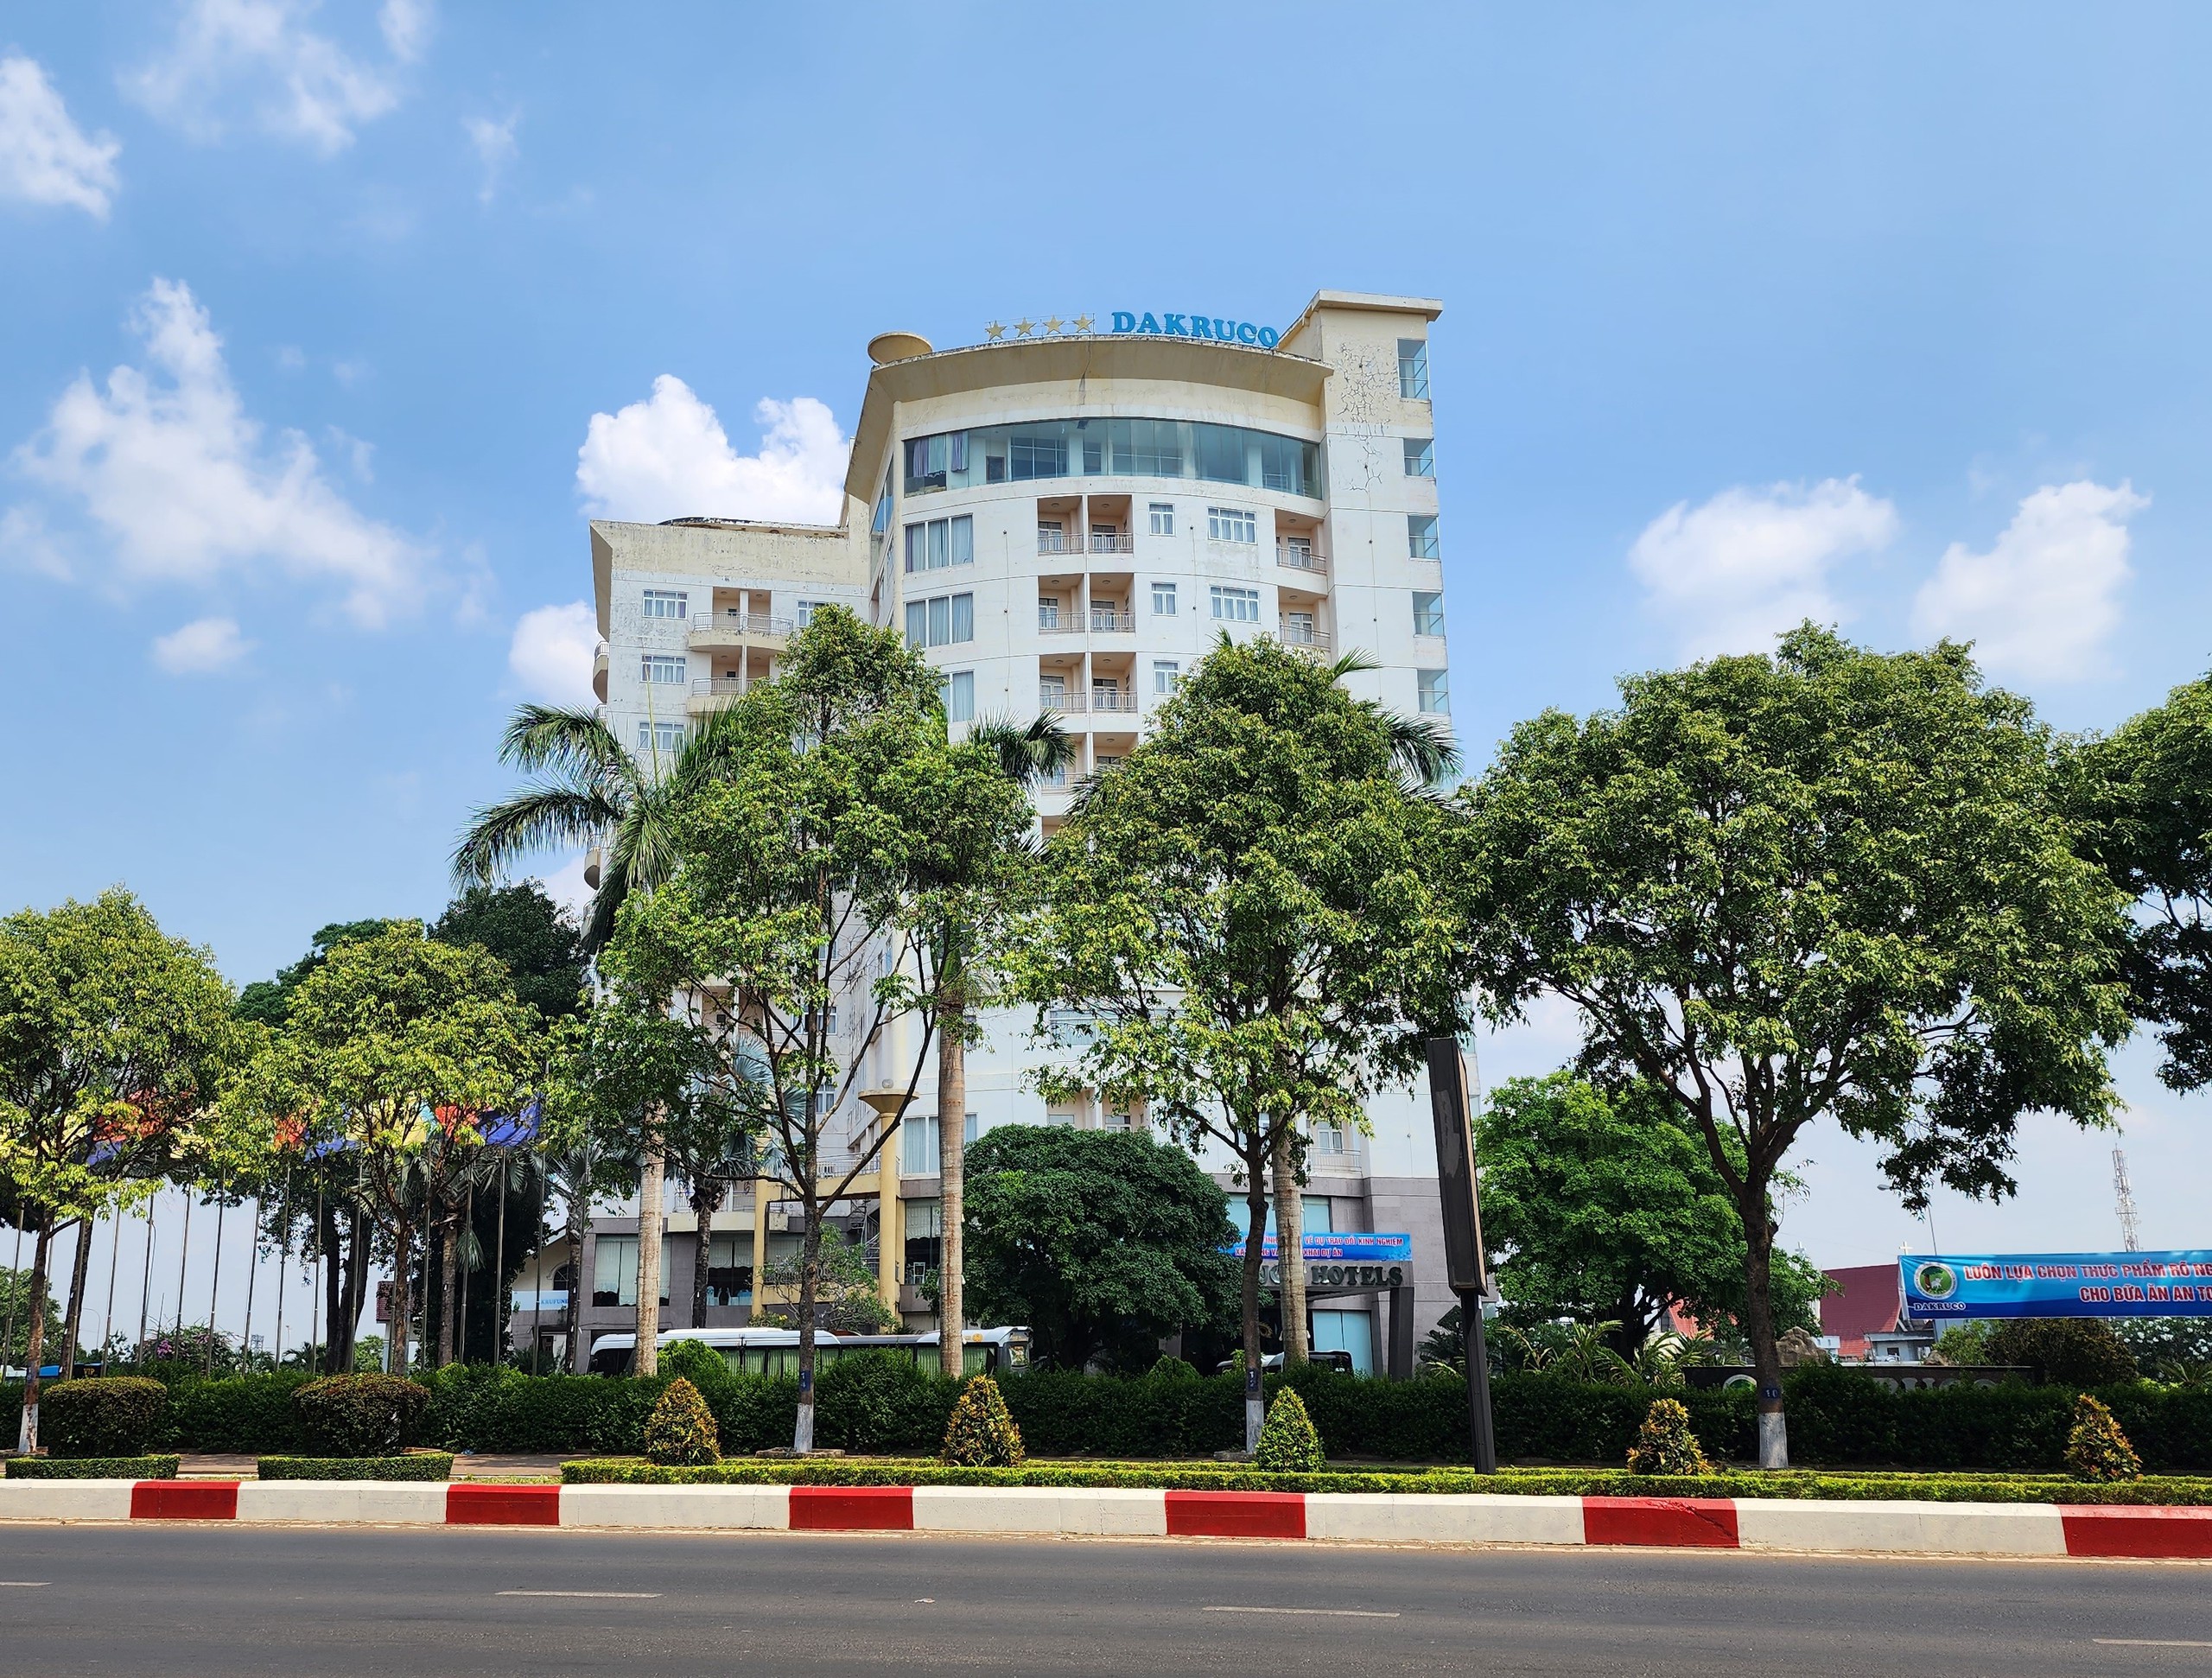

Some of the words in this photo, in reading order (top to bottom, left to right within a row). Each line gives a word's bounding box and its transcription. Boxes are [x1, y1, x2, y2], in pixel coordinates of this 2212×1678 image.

[1112, 312, 1279, 348] DAKRUCO
[1326, 1236, 1344, 1245] TRAO
[1357, 1236, 1375, 1245] KINH
[1376, 1236, 1403, 1246] NGHIỆM
[1303, 1248, 1320, 1256] KHAI
[1311, 1266, 1403, 1286] HOTELS
[1965, 1263, 2002, 1280] LUÔN
[2005, 1264, 2034, 1282] LỰA
[2037, 1265, 2077, 1281] CHỌN
[2081, 1264, 2118, 1281] THỰC
[2122, 1260, 2166, 1278] PHẨM
[2169, 1262, 2190, 1277] RÕ
[2080, 1287, 2110, 1302] CHO
[2113, 1285, 2145, 1301] BỮA
[2147, 1283, 2170, 1301] ĂN
[2172, 1286, 2196, 1301] AN
[1913, 1301, 1967, 1311] DAKRUCO
